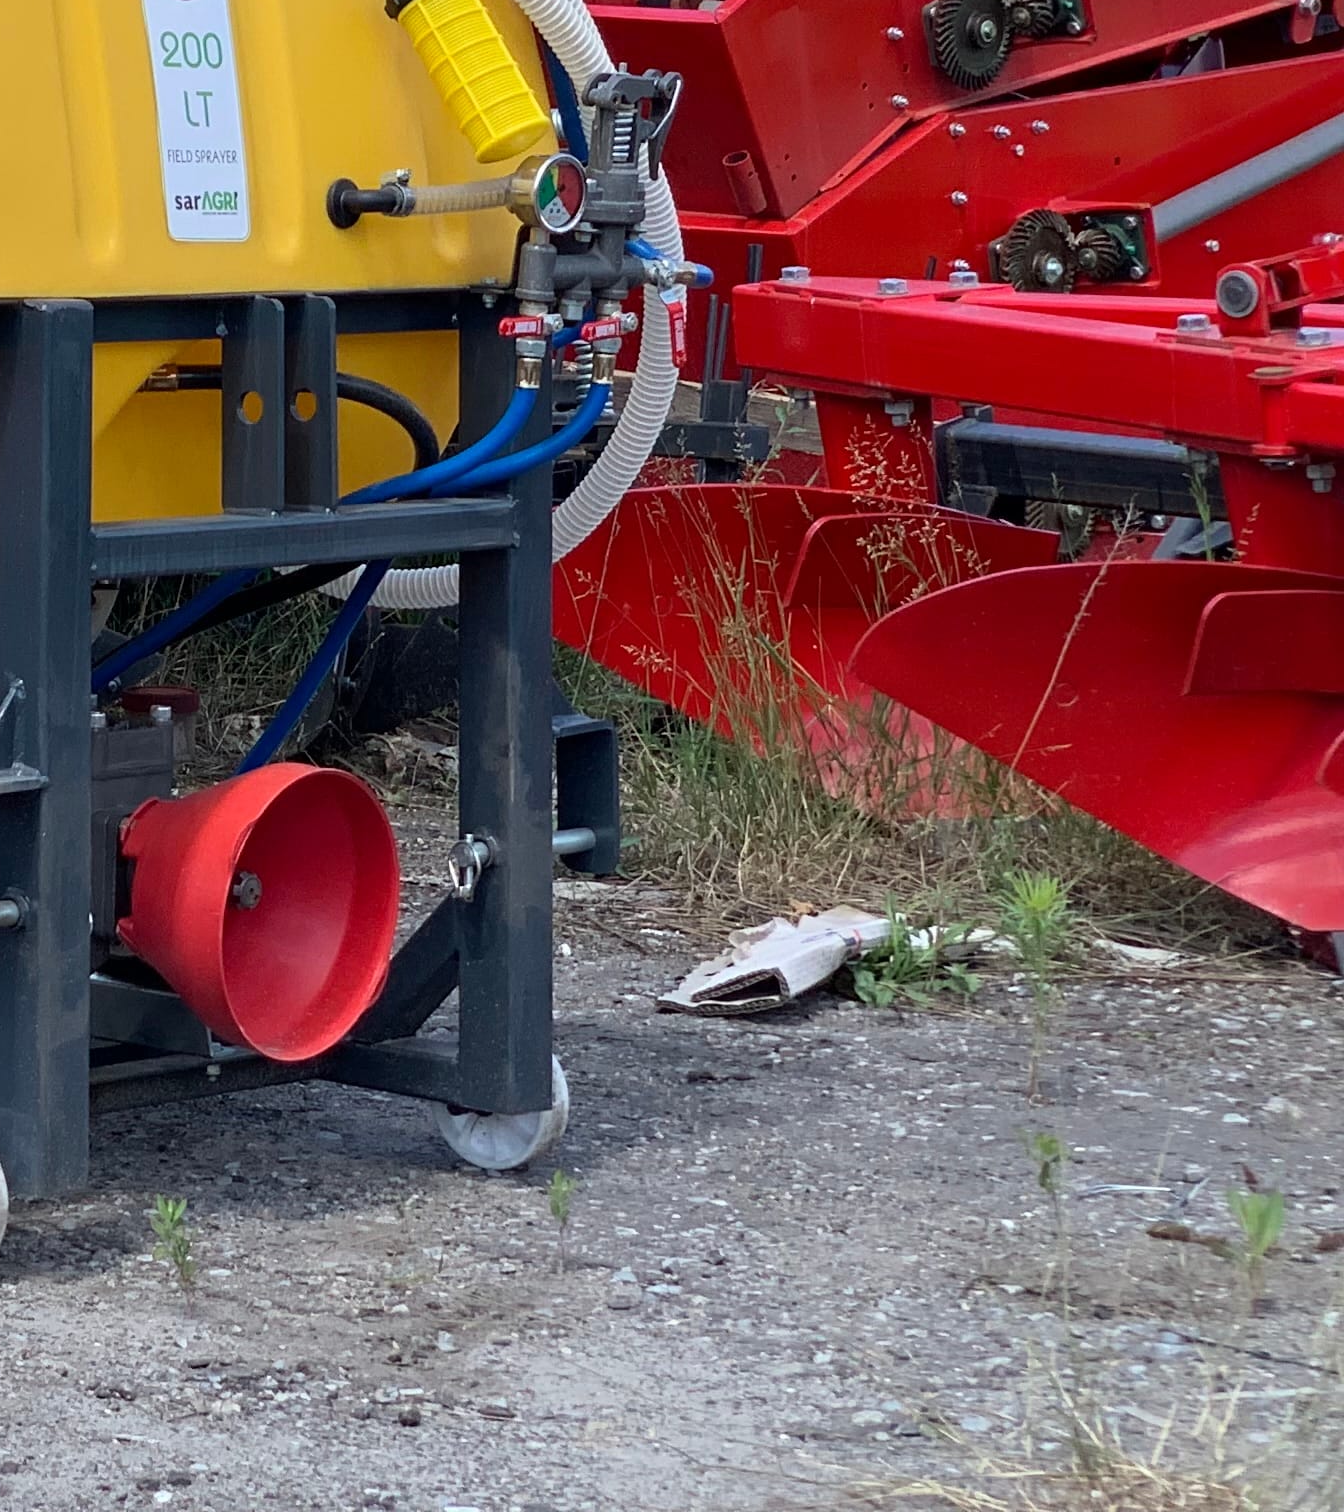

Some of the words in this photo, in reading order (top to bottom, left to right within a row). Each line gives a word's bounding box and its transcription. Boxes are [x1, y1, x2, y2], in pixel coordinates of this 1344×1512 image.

[160, 30, 223, 70] 200
[183, 90, 213, 127] LT
[167, 149, 193, 163] FIELD
[195, 149, 238, 164] SPRAYER
